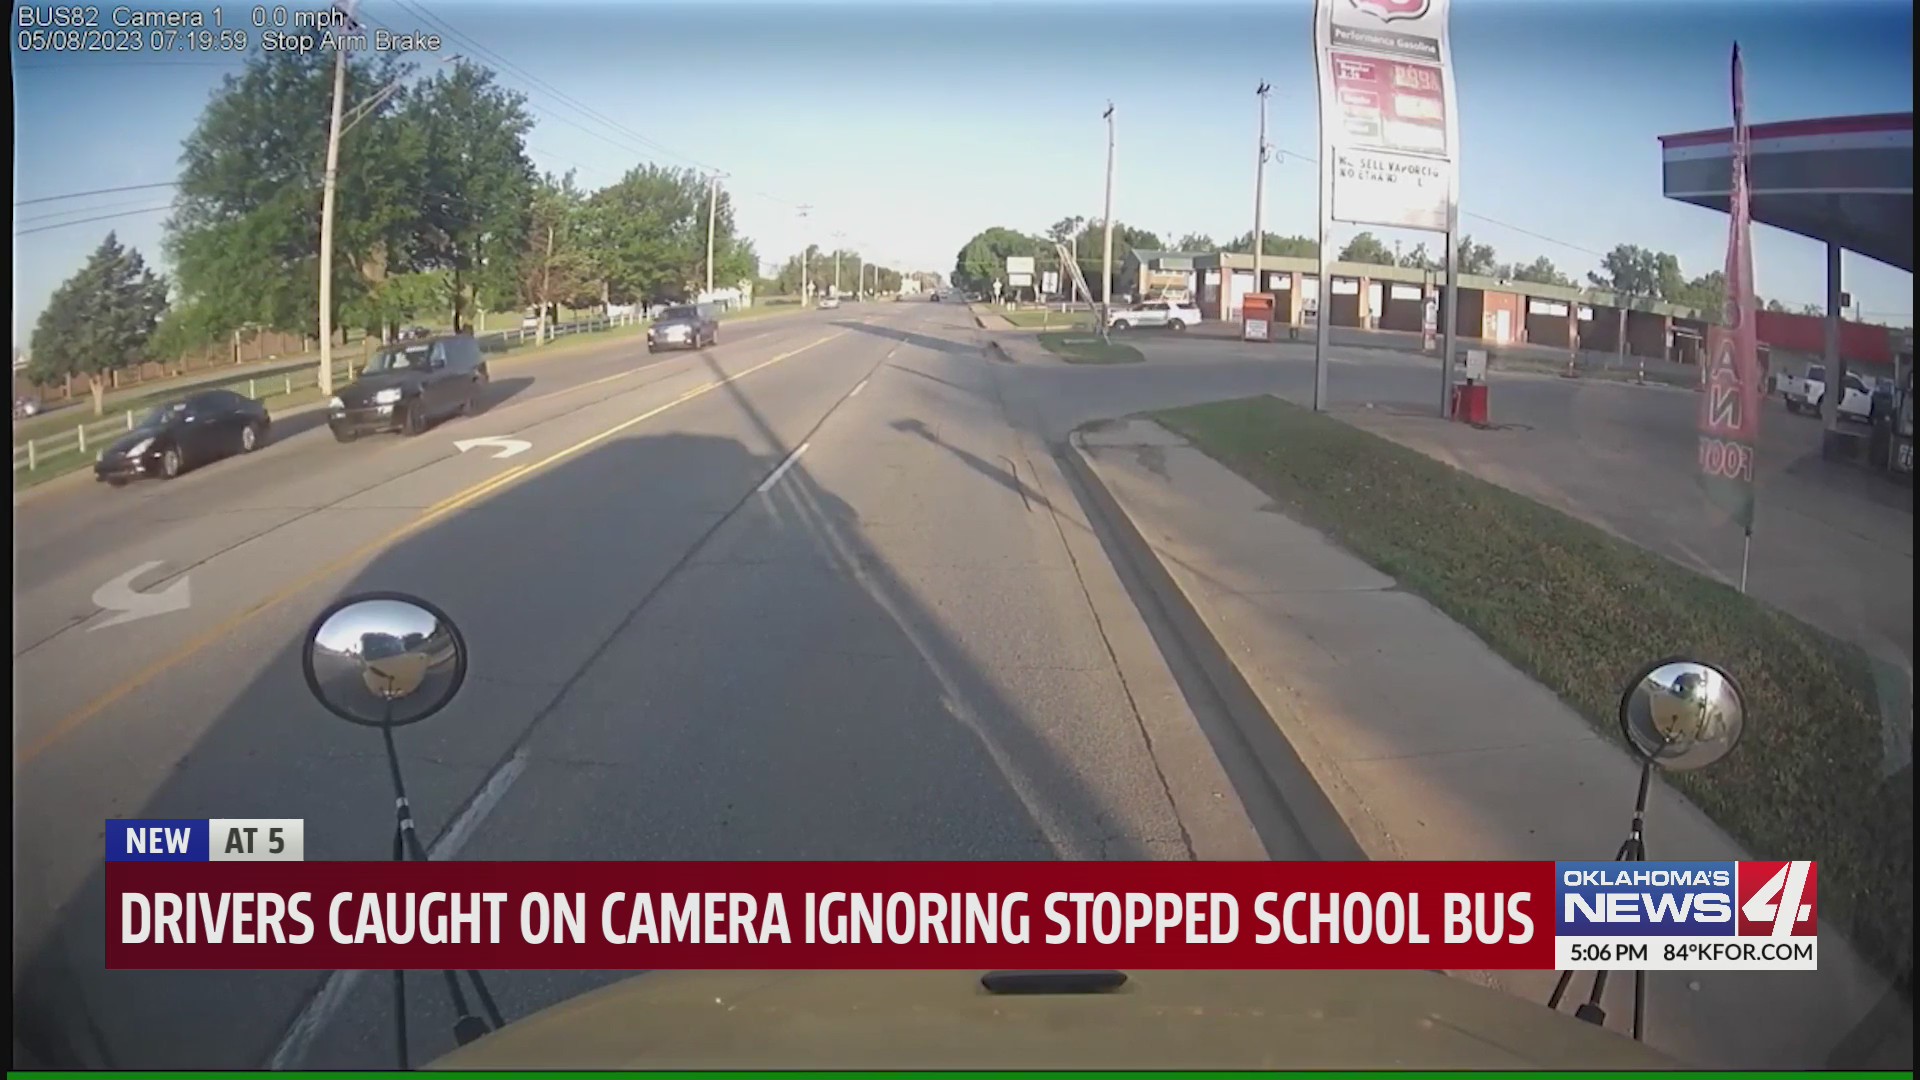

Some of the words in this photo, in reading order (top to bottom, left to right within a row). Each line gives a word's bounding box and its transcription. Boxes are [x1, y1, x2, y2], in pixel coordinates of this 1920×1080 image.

[1334, 28, 1395, 47] Performance
[1396, 38, 1436, 54] Gasoline
[1360, 158, 1384, 171] SELL
